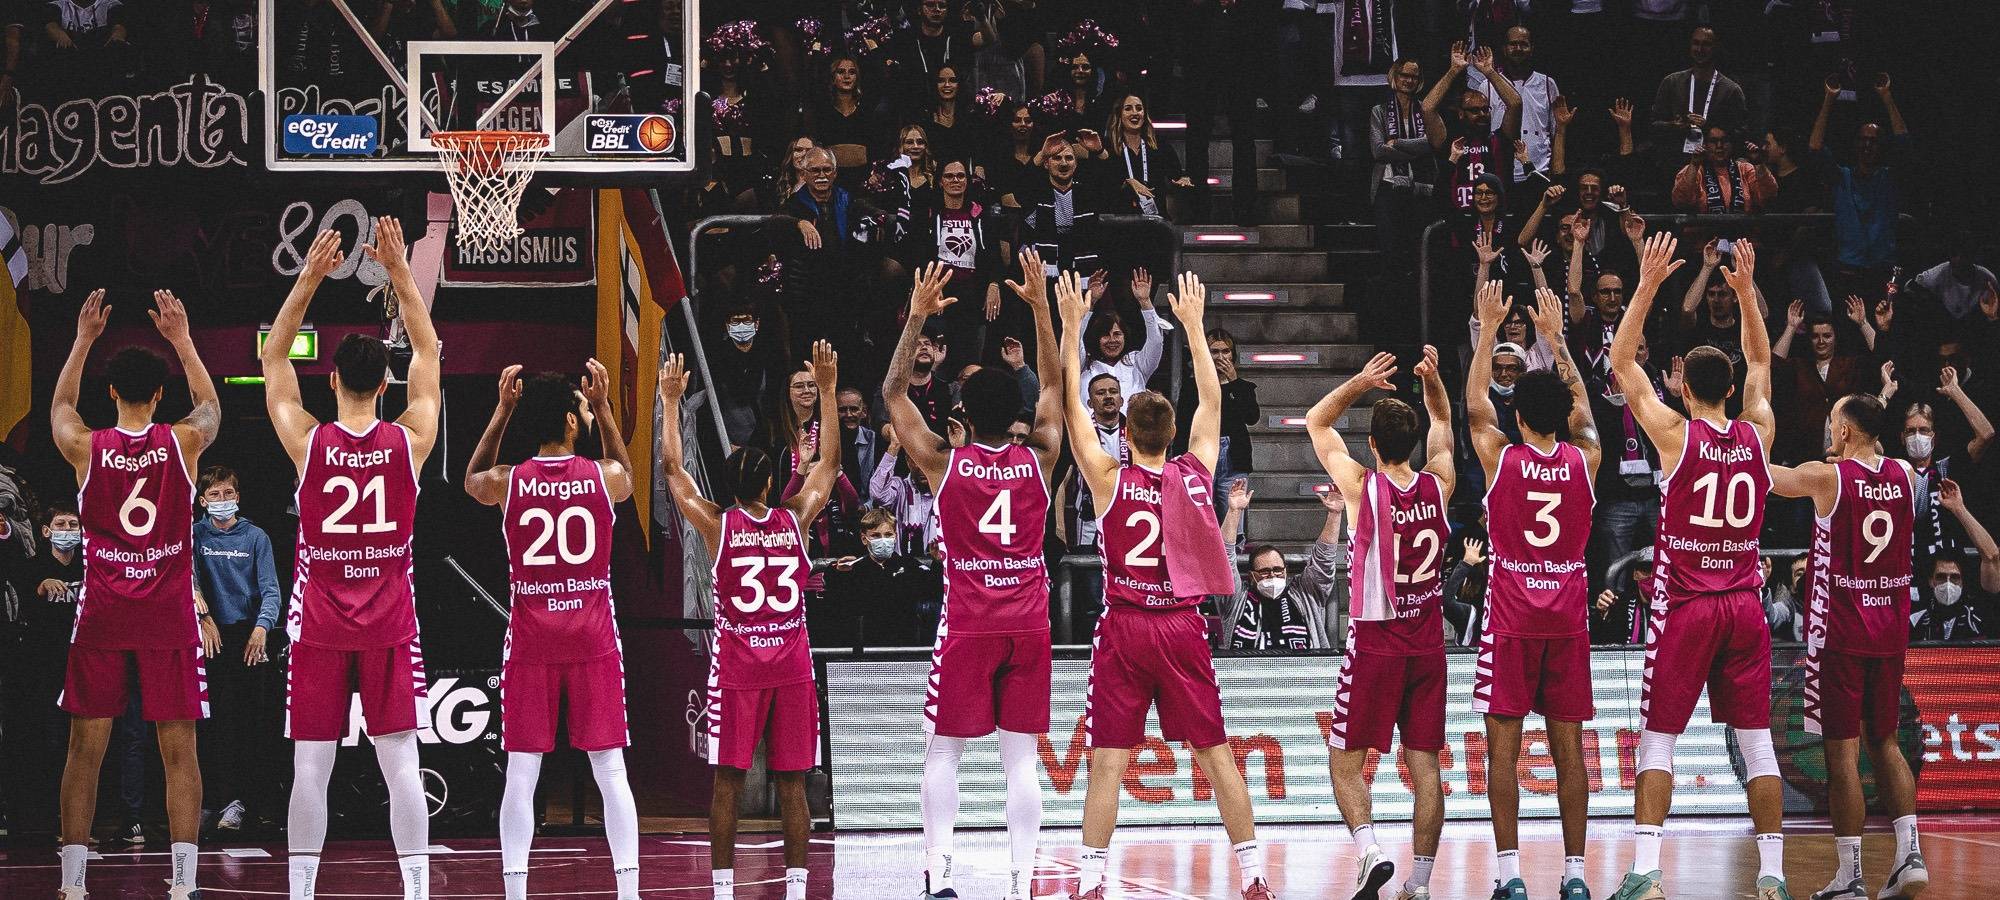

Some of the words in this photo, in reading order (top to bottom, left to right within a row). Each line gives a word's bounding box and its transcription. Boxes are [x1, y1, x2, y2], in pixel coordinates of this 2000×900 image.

[602, 125, 630, 134] Credit
[311, 134, 369, 150] Credit
[591, 134, 629, 149] BBL
[101, 446, 168, 472] Kessens
[325, 445, 393, 469] Kratzer
[957, 458, 1034, 481] Gorham
[1520, 459, 1571, 482] Ward
[518, 477, 596, 501] Morgan
[1689, 471, 1756, 528] 10
[1854, 479, 1903, 501] Tadda
[118, 477, 157, 537] 6
[321, 475, 397, 534] 21
[978, 488, 1017, 546] 4
[1523, 491, 1562, 548] 3
[519, 505, 596, 566] 20
[1667, 534, 1720, 553] Telekom
[1862, 509, 1894, 564] 9
[308, 545, 363, 561] Telekom
[1701, 555, 1734, 569] Bonn
[344, 564, 380, 579] Bonn
[984, 574, 1021, 588] Bonn
[1833, 574, 1877, 590] Telekom
[730, 555, 800, 613] 33
[1525, 576, 1560, 590] Bonn
[547, 598, 583, 612] Bonn
[1862, 593, 1892, 607] Bonn
[749, 635, 785, 648] Bonn
